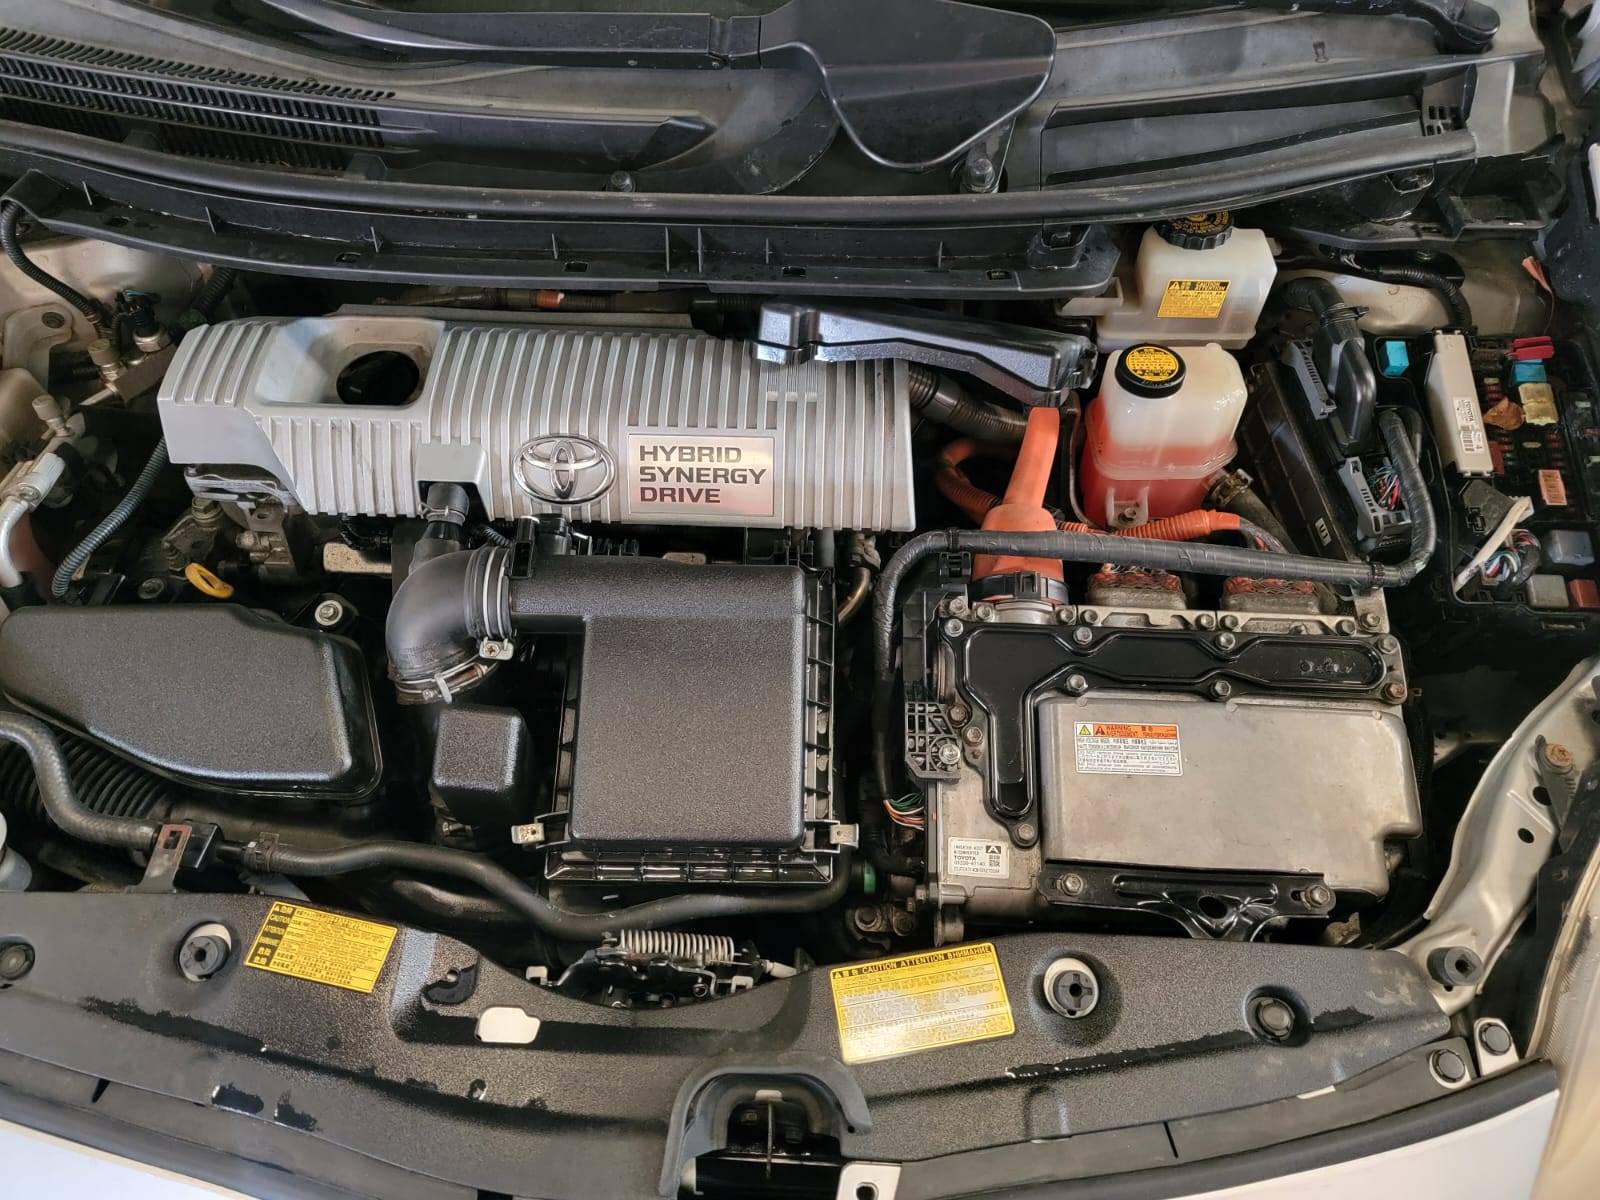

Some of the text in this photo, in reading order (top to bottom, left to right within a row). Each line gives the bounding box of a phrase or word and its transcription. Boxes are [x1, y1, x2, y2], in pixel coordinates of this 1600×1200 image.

[1465, 400, 1474, 422] TOYOTA
[639, 445, 742, 463] HYBRID
[639, 466, 767, 485] SYNERGY
[640, 486, 721, 504] DRIVE
[862, 961, 897, 975] CAUTION
[899, 953, 945, 968] ATTENTION
